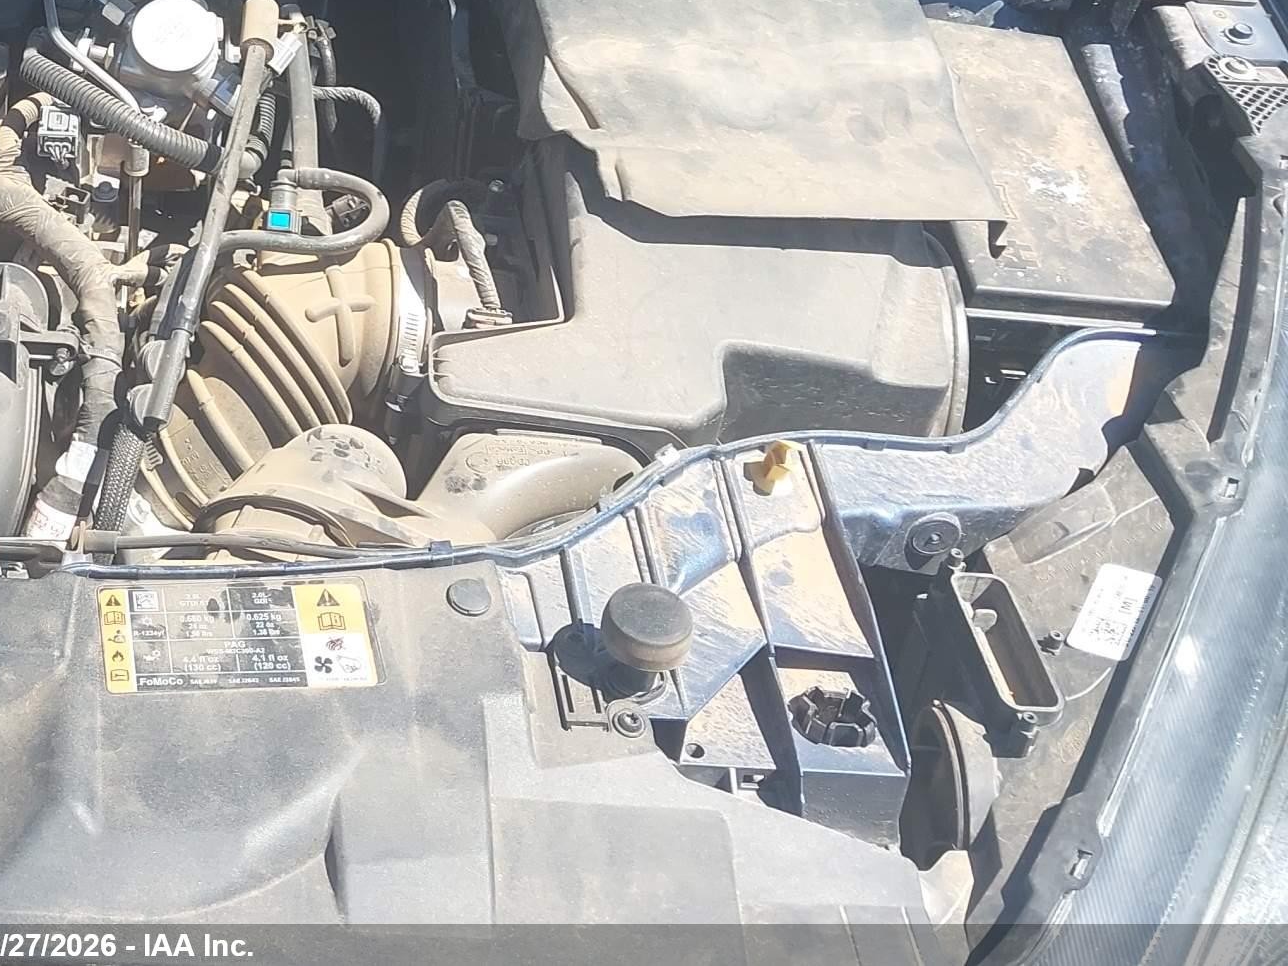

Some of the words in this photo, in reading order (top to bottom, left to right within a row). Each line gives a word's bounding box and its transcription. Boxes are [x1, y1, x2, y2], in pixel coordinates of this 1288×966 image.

[246, 613, 269, 621] 0.625
[270, 613, 282, 621] kg
[223, 640, 246, 648] PAG
[252, 654, 266, 662] 4.1
[268, 654, 275, 662] fl
[184, 663, 205, 672] (130
[206, 663, 221, 672] cc)
[253, 662, 274, 671] (120
[275, 661, 291, 670] cc)
[139, 677, 184, 686] FoMoCo
